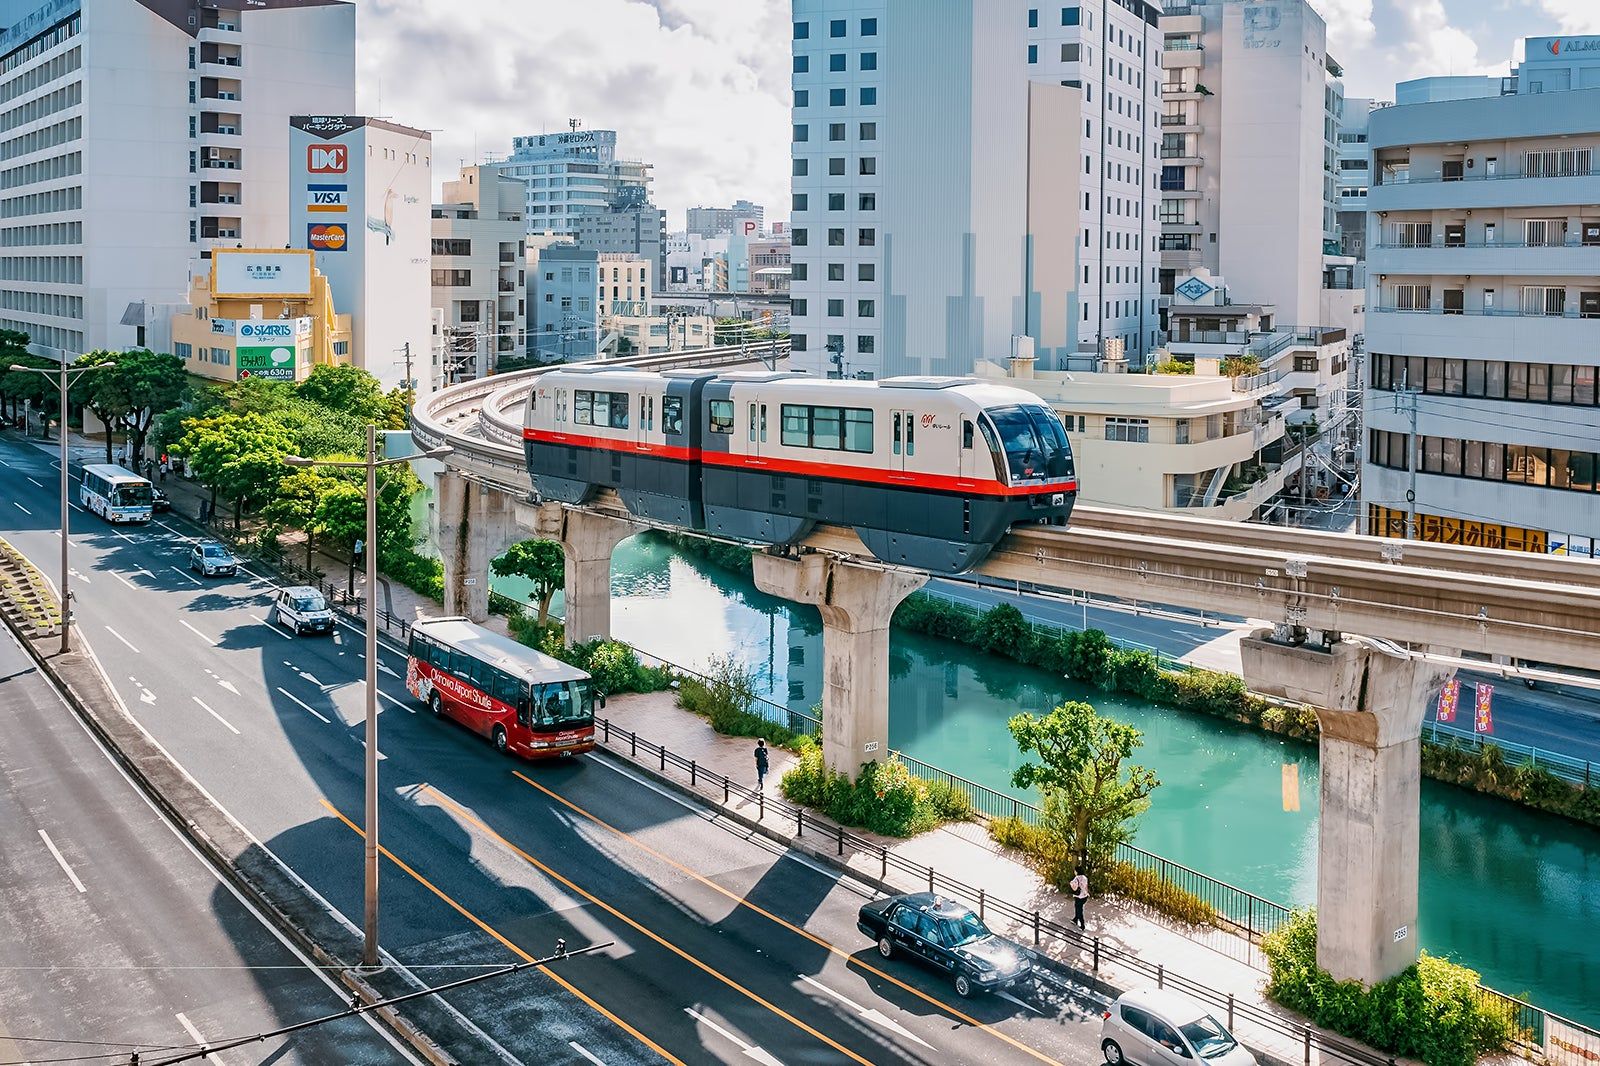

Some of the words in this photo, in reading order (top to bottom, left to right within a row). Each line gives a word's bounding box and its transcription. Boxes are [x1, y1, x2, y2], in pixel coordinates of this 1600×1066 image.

[313, 192, 341, 204] VISA
[744, 221, 756, 236] P
[310, 233, 345, 241] MasterCard
[253, 324, 292, 336] STARTS
[430, 667, 454, 691] Okinawa
[454, 681, 473, 700] Airport
[472, 689, 492, 709] Shuttle
